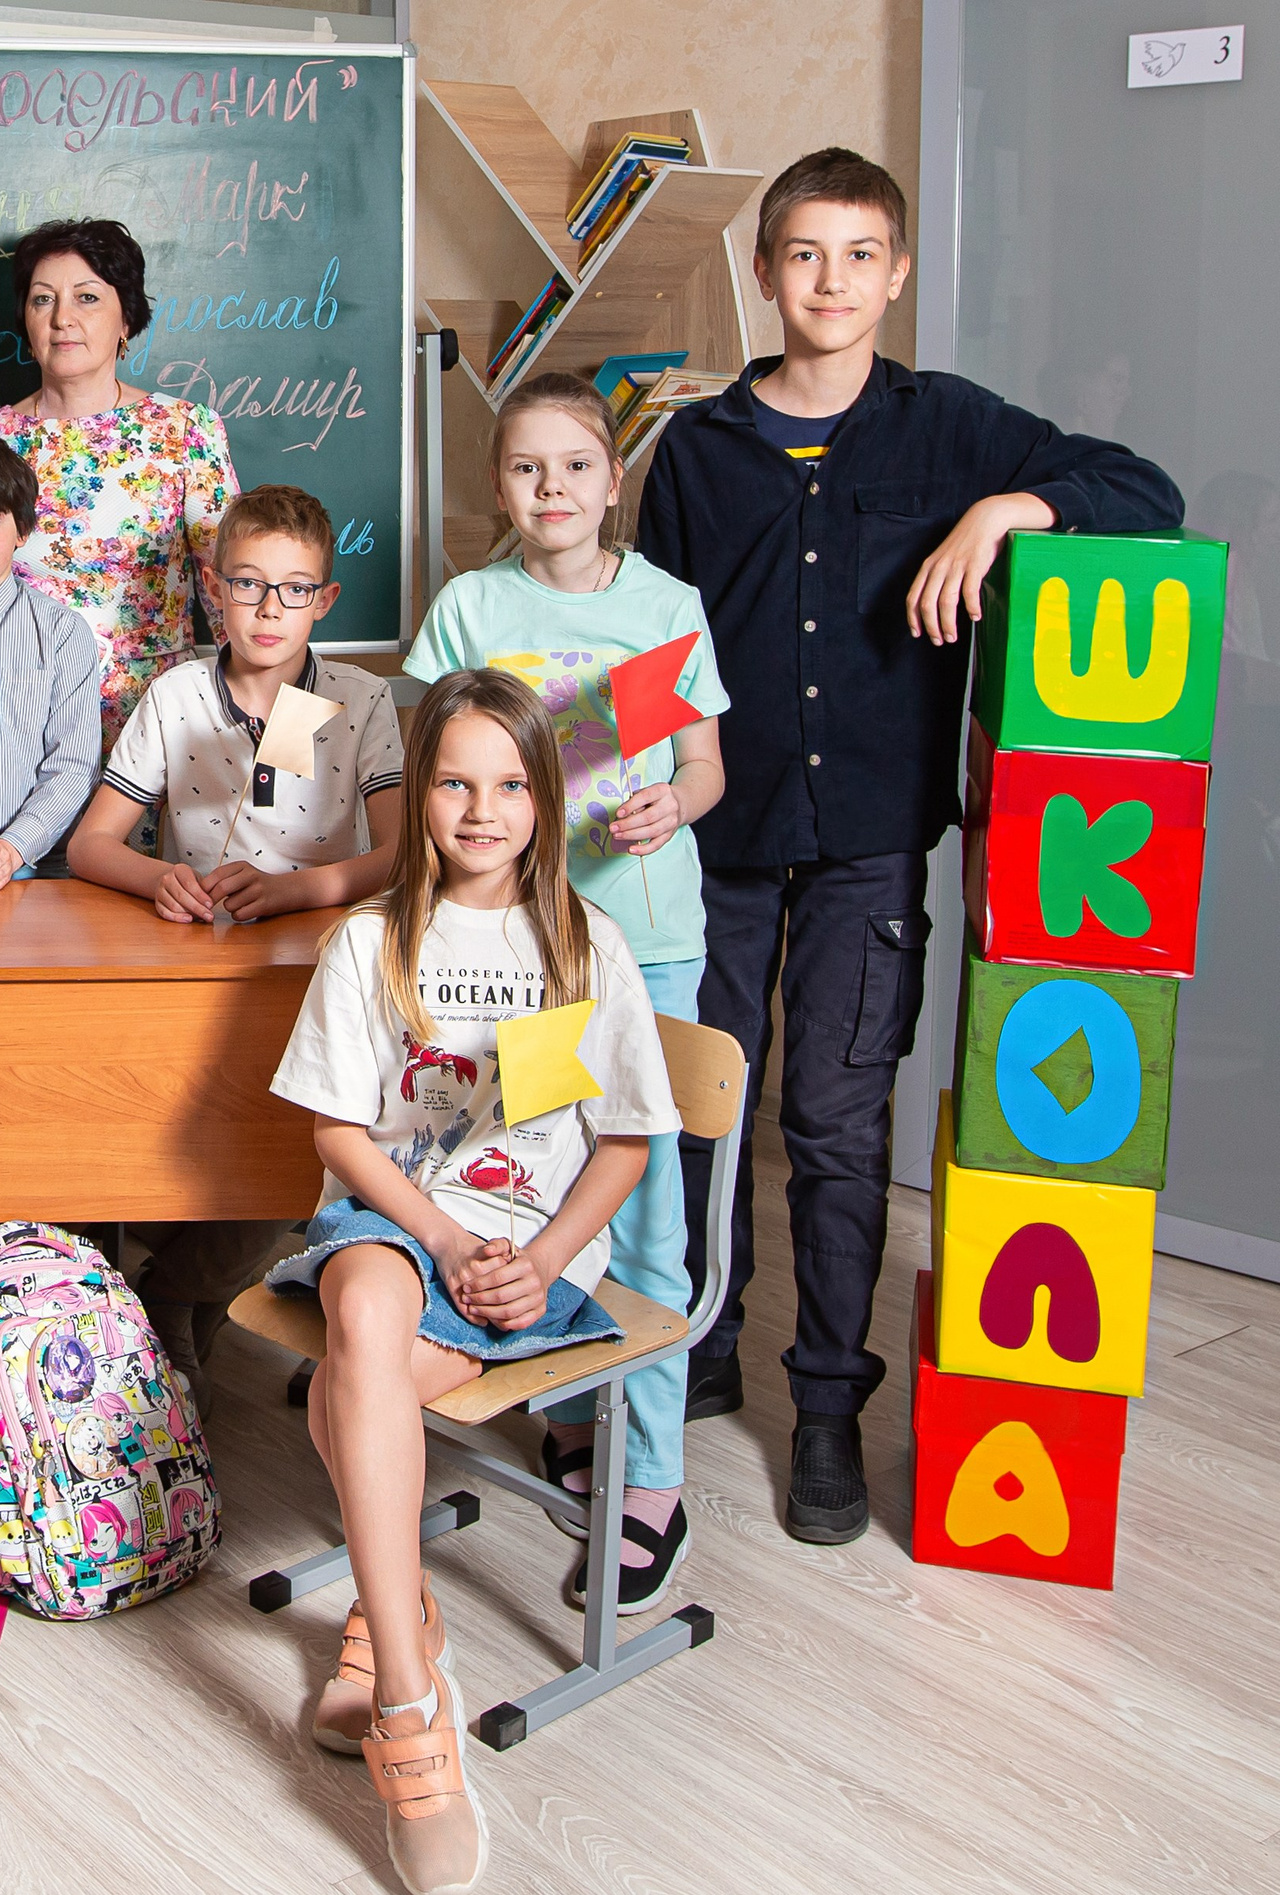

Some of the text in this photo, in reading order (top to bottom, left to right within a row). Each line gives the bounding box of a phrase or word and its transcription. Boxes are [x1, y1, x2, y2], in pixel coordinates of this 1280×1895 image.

[1214, 35, 1230, 64] 3
[144, 155, 310, 258] Марк
[130, 256, 341, 376] рослав
[437, 968, 504, 979] CLOSER
[419, 984, 427, 999] T
[438, 984, 514, 1006] OCEAN
